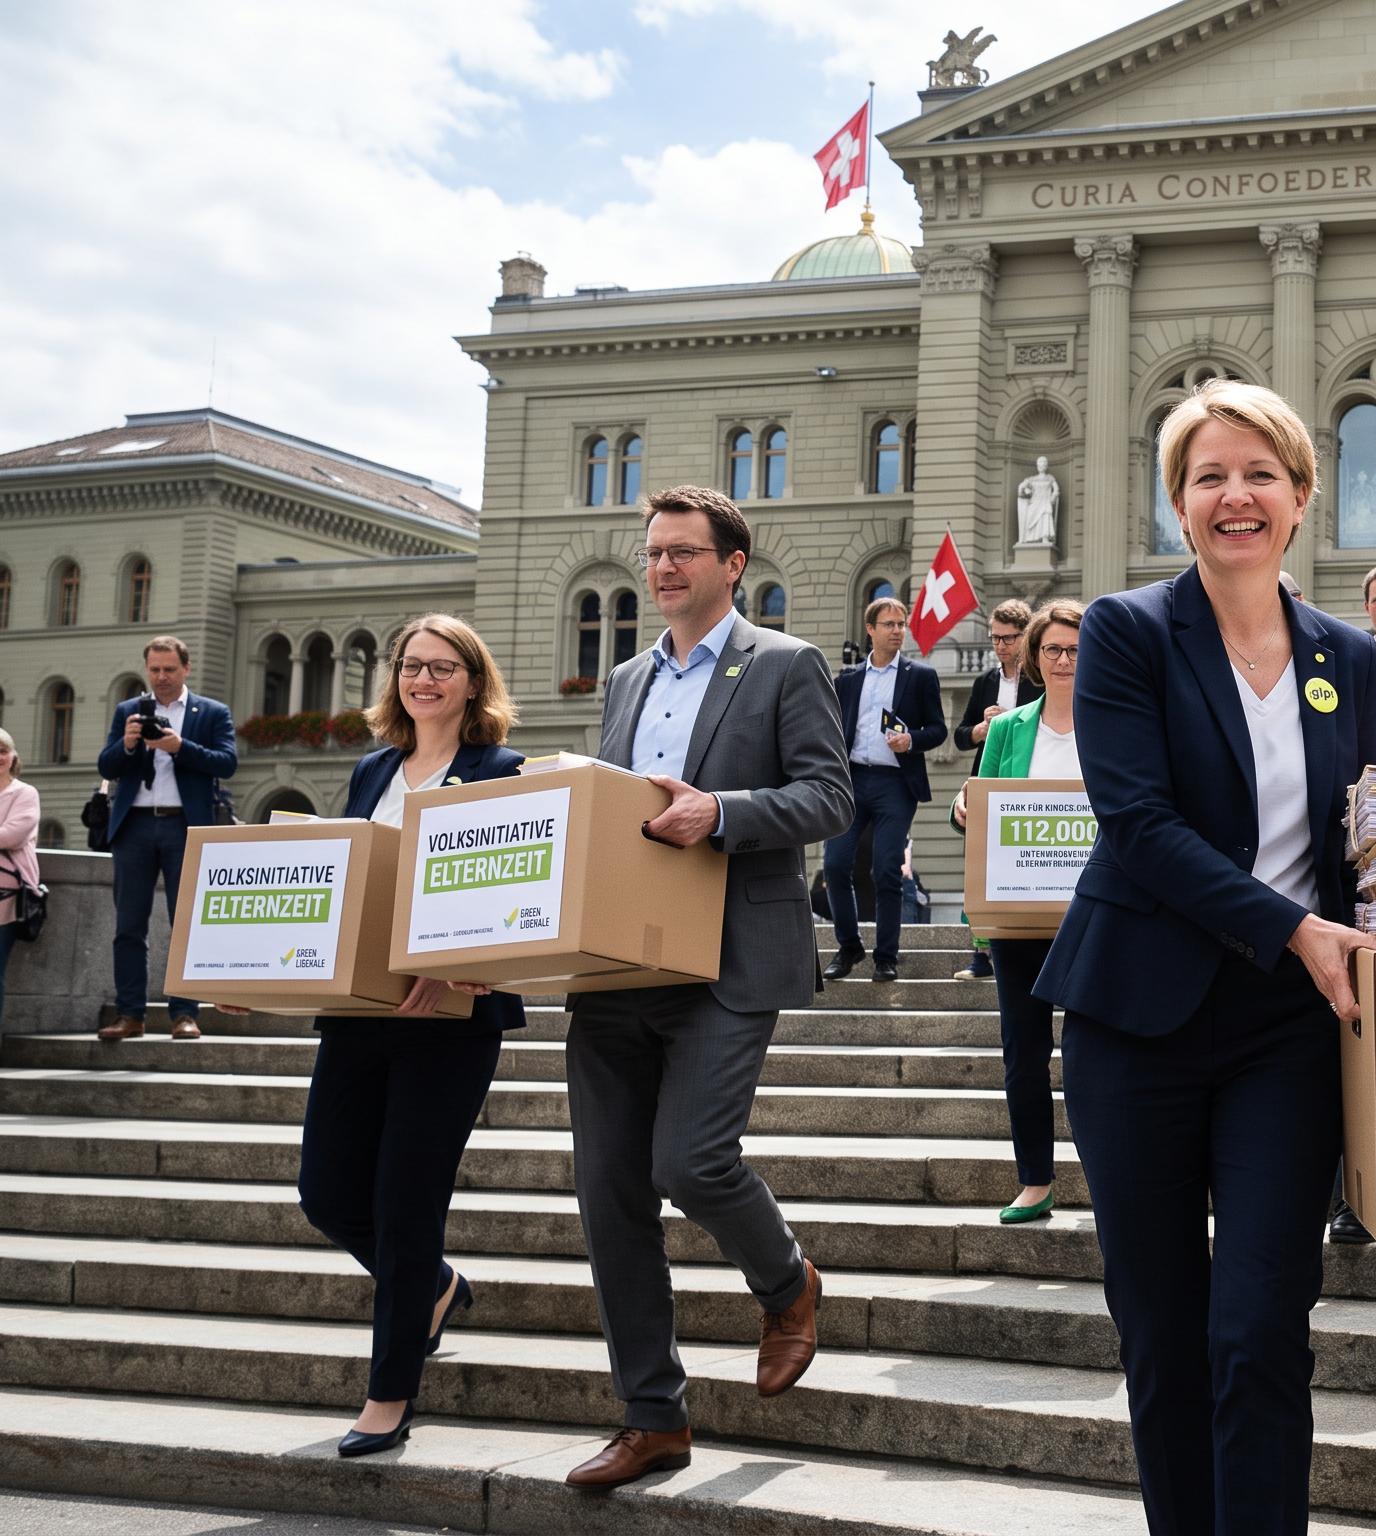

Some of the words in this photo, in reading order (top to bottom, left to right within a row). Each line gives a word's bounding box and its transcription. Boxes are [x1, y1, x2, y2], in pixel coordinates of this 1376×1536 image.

[1031, 181, 1137, 209] CURIA
[1000, 804, 1026, 812] STARK
[1028, 803, 1043, 812] FÜR
[428, 818, 555, 853] VOLKSINITIATIVE
[208, 865, 335, 886] VOLKSINITIATIVE
[430, 849, 547, 888] ELTERNZEIT
[207, 893, 325, 919] ELTERNZEIT
